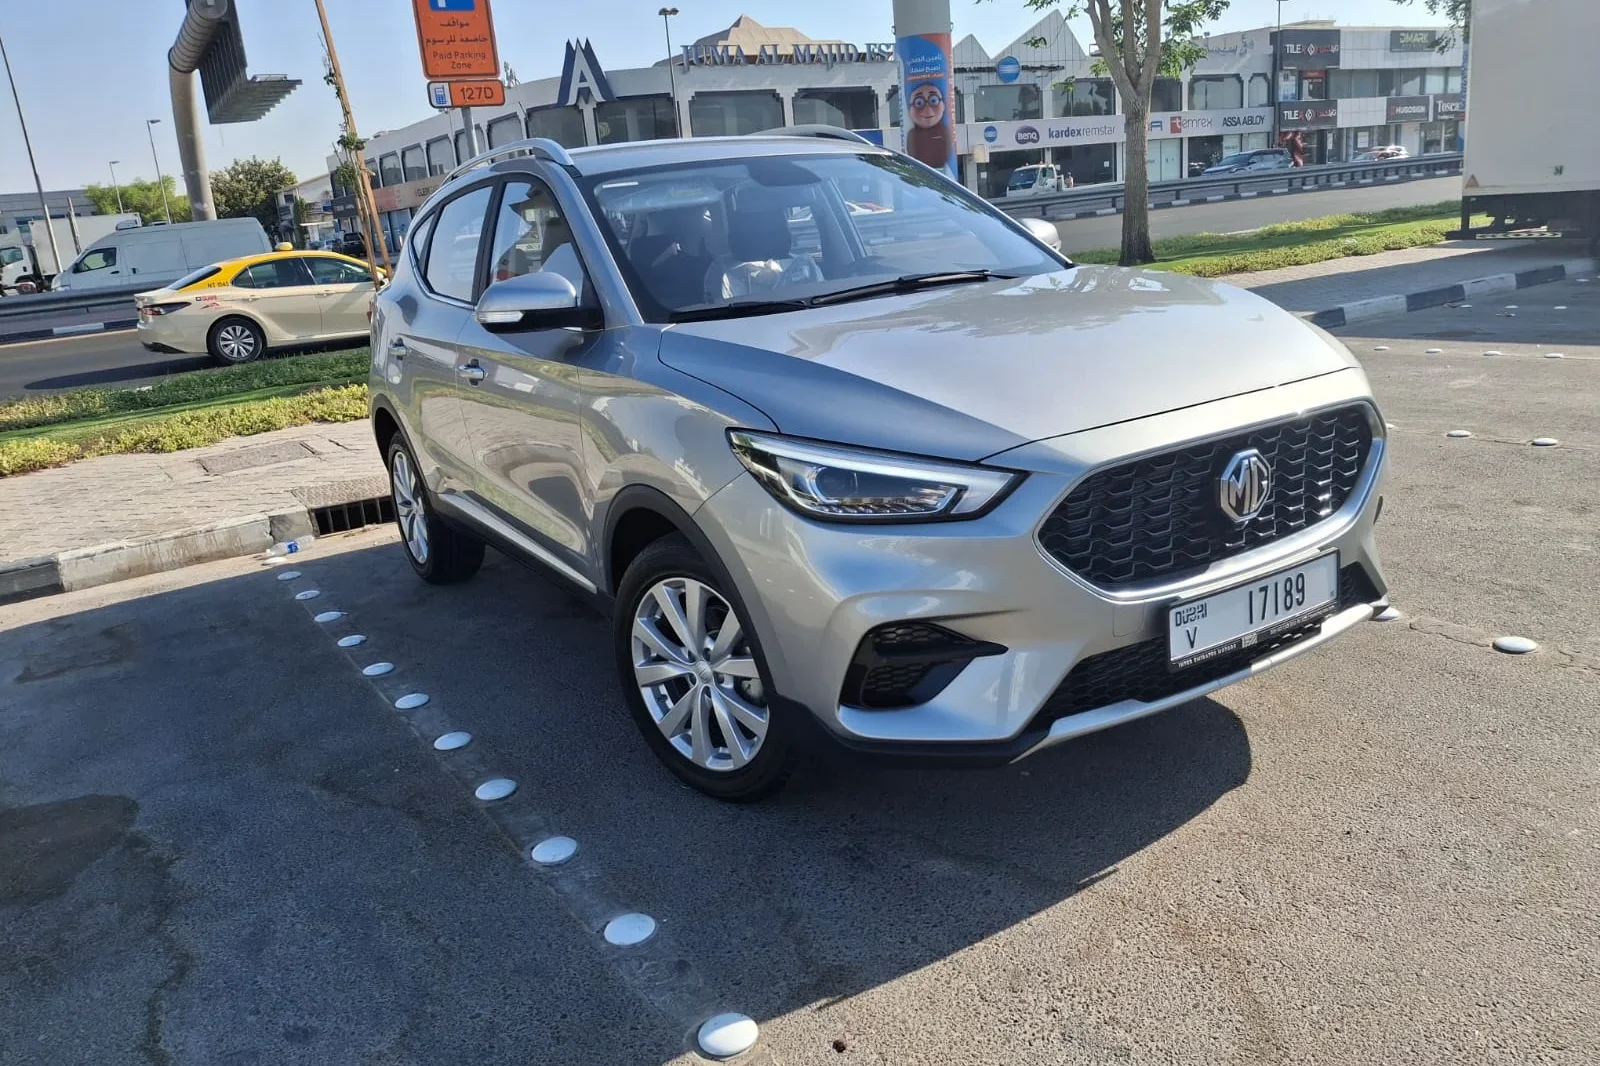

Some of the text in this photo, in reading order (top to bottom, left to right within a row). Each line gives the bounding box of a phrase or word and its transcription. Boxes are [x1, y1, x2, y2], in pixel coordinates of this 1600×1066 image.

[433, 50, 486, 60] Paid Parking
[680, 44, 745, 74] JUMA
[757, 44, 784, 65] AL
[791, 43, 860, 71] MAJID
[451, 61, 472, 70] Zone
[460, 86, 494, 101] 127D
[1222, 116, 1242, 127] ASSA
[1242, 114, 1266, 126] ABLOY
[1228, 455, 1269, 515] MG
[1248, 572, 1306, 625] 17189
[1186, 626, 1198, 649] V
